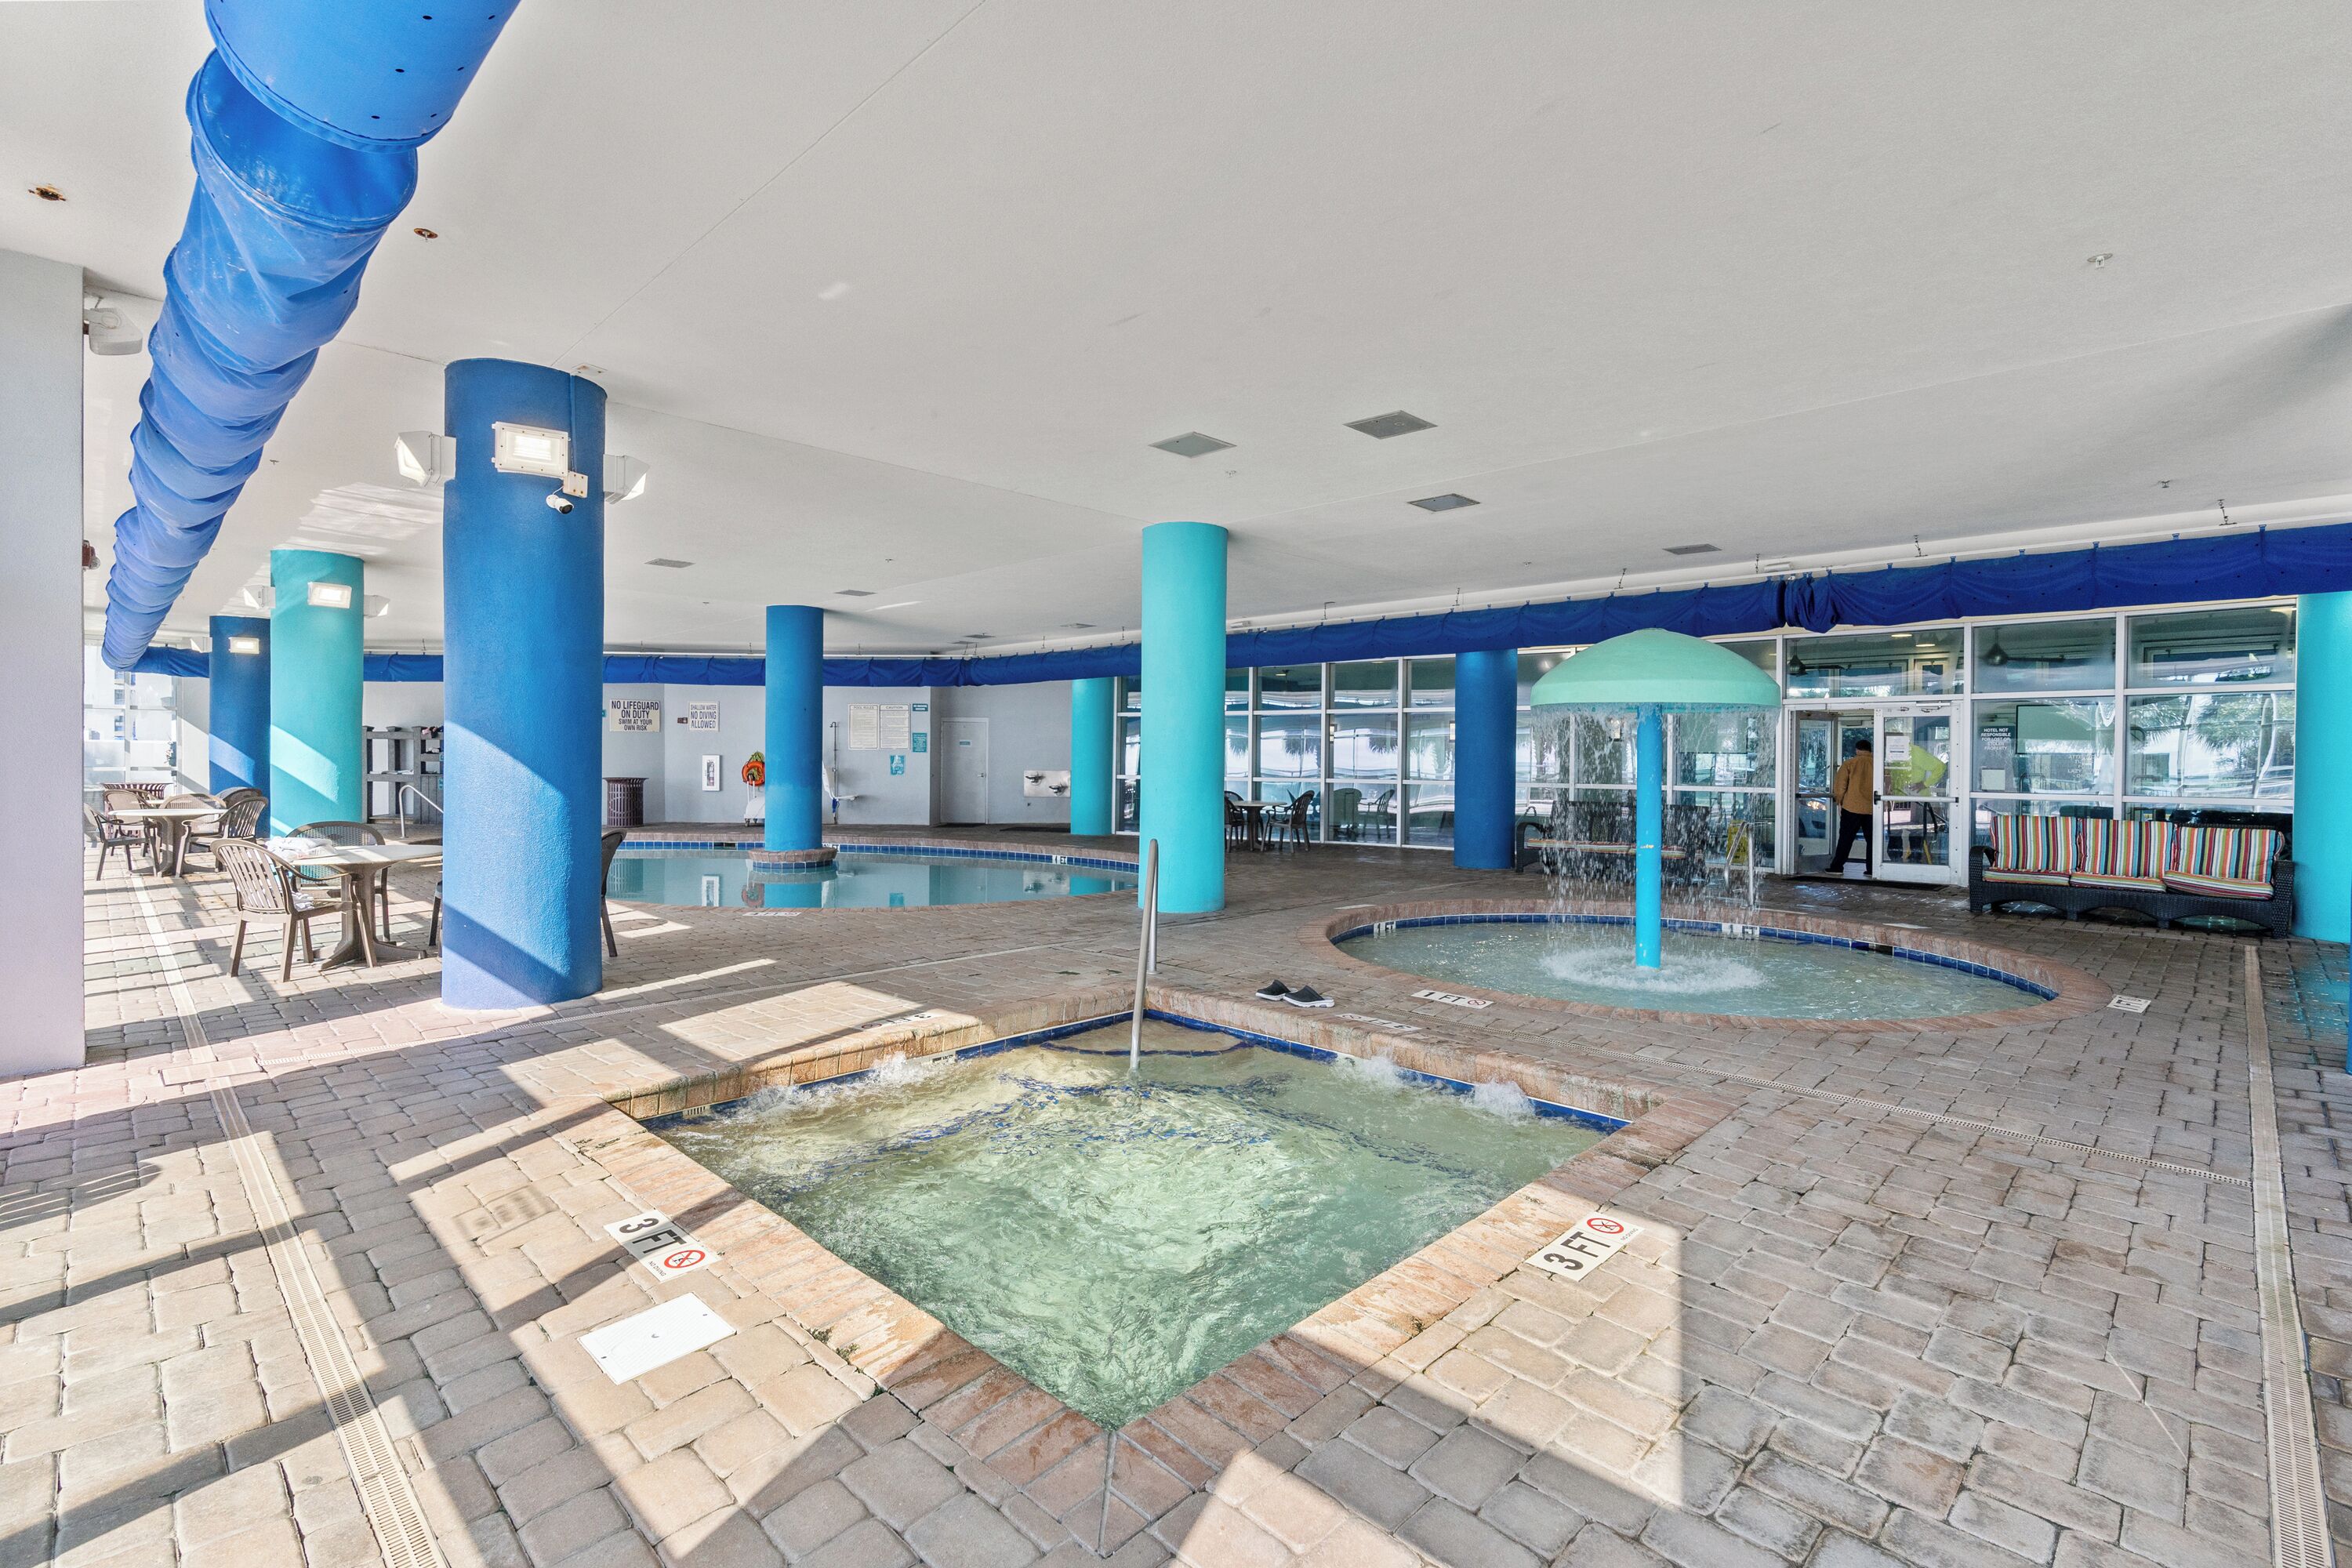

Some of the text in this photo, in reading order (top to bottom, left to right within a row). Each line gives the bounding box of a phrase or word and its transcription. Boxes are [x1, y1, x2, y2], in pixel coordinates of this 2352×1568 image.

[623, 701, 659, 710] LIFEGUARD
[622, 710, 630, 718] ON
[699, 711, 717, 720] DIVING
[691, 720, 716, 728] ALLOWED
[619, 1218, 687, 1254] 3 FT
[1544, 1231, 1611, 1271] 3 FT
